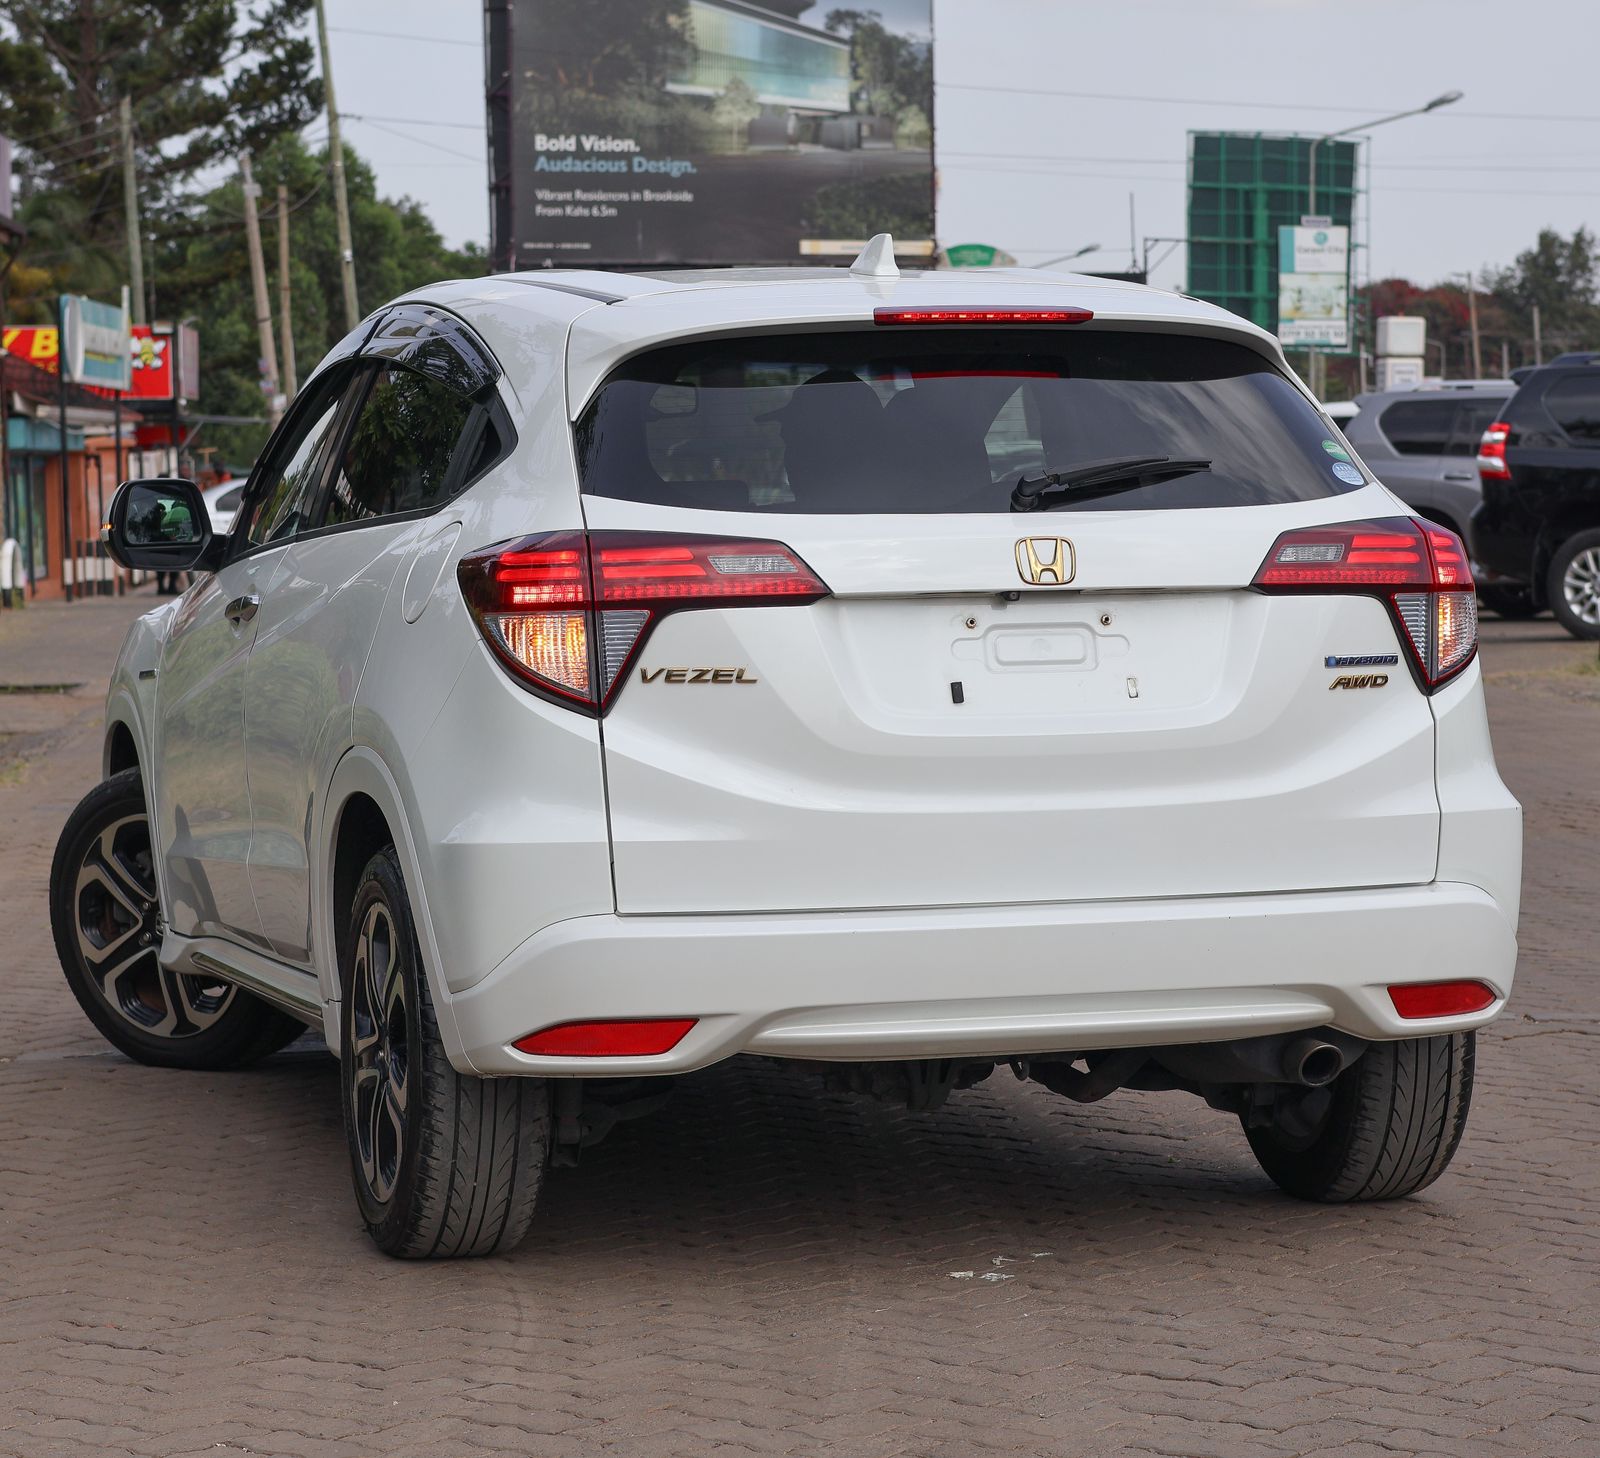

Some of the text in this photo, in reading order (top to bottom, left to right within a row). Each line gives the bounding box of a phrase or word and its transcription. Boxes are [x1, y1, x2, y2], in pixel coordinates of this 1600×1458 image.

[534, 133, 640, 152] Bold Vision.
[534, 155, 697, 178] Audacious Design.
[535, 189, 694, 202] Vibrant Residences in Brookside
[535, 204, 563, 217] From
[1339, 656, 1397, 666] HYBRID
[640, 667, 758, 684] VEZEL
[1329, 673, 1389, 690] AWD
